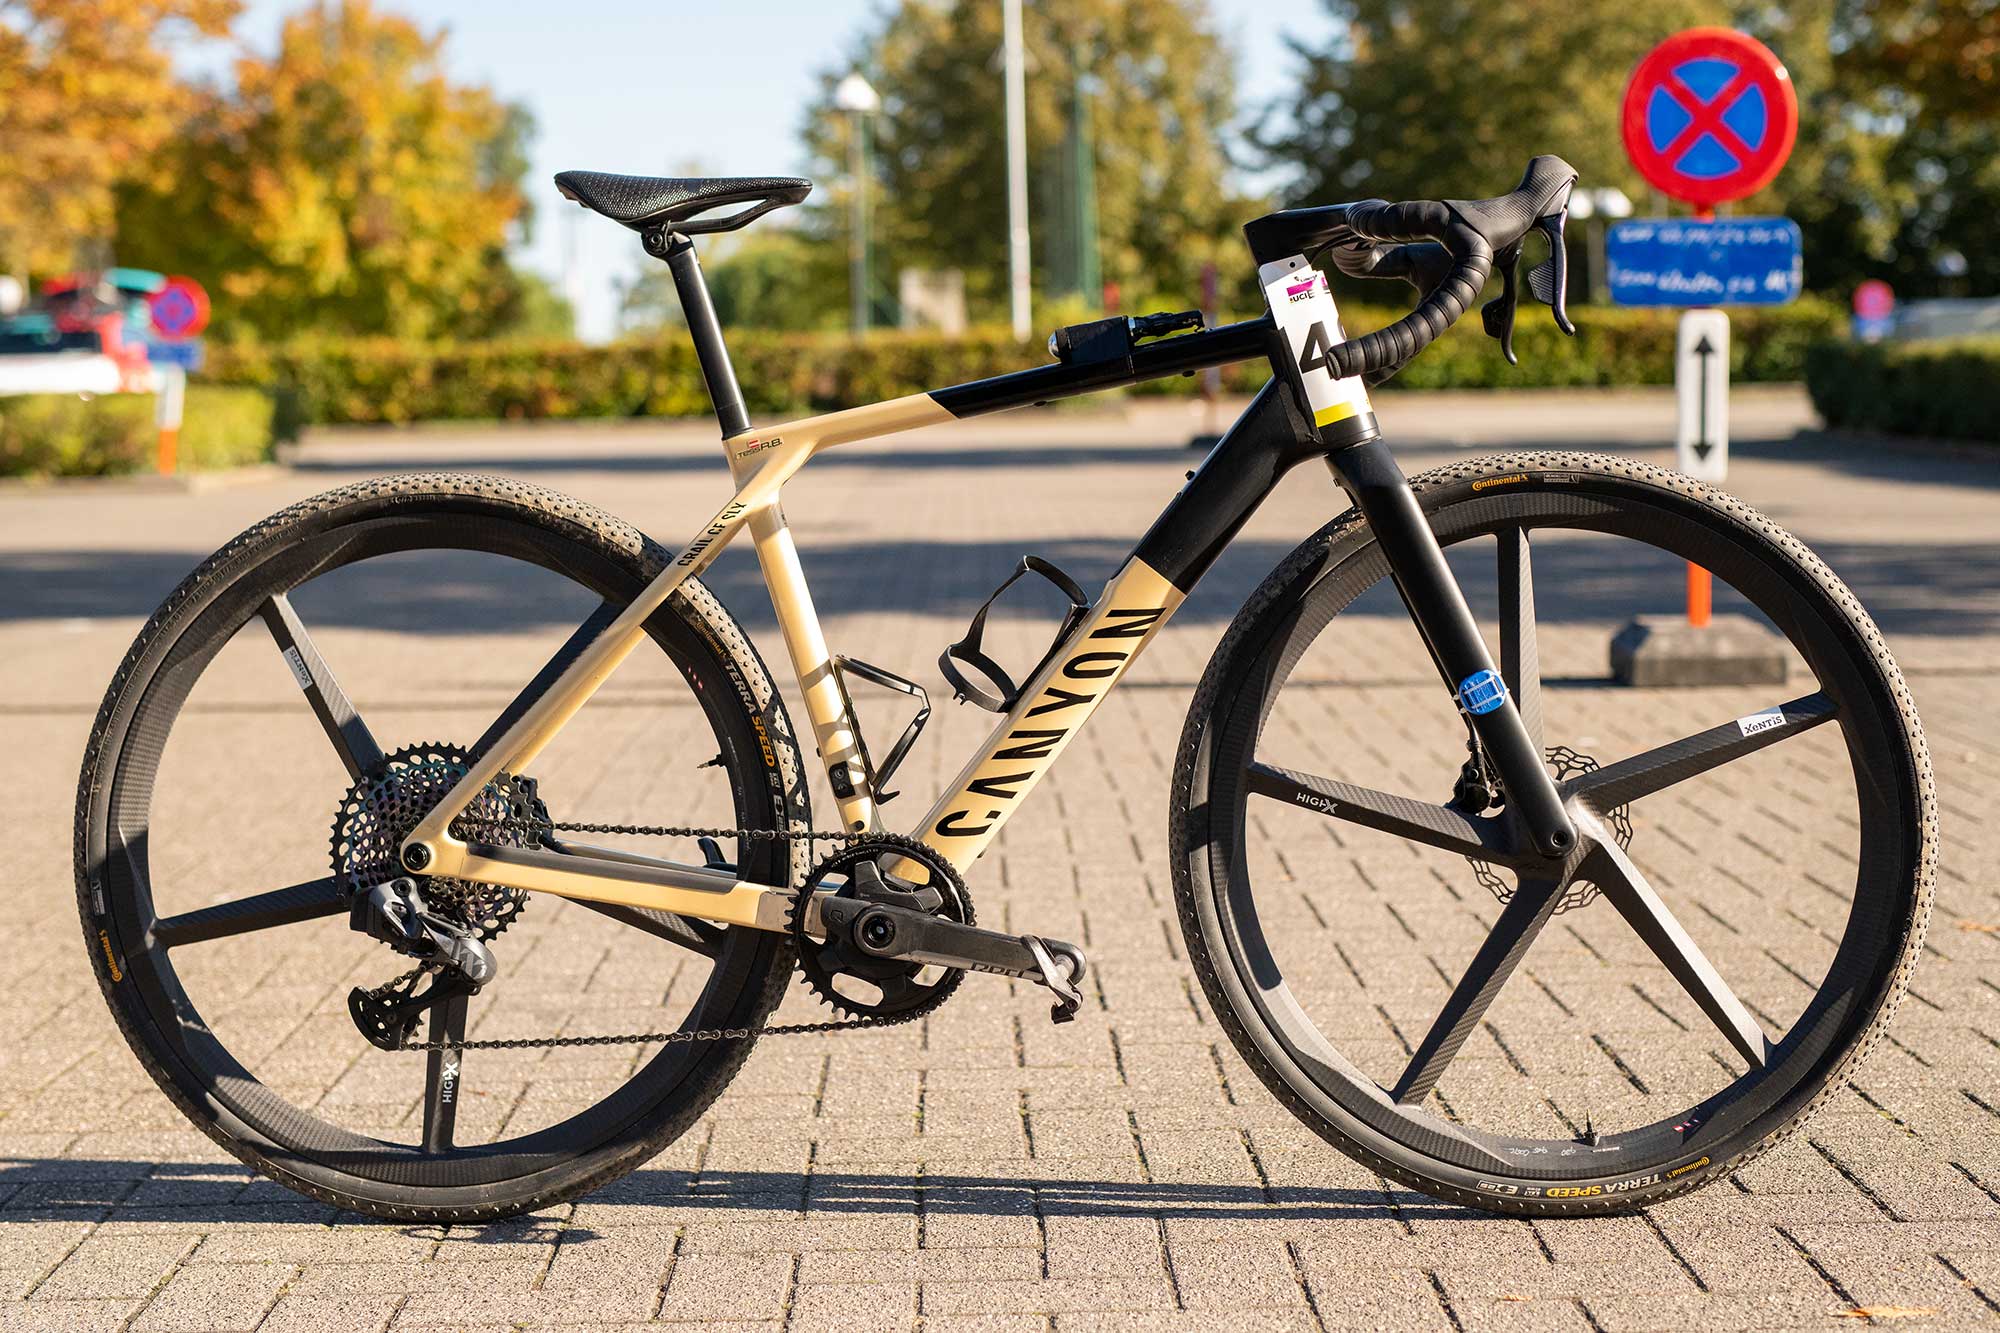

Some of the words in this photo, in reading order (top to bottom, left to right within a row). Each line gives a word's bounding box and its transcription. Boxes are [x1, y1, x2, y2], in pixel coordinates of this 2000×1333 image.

[1299, 320, 1346, 379] 4
[1472, 475, 1521, 491] Continental
[677, 538, 714, 567] GRAIL
[707, 523, 726, 535] CF
[721, 502, 747, 520] SLX
[725, 663, 758, 715] TERRA
[752, 715, 775, 767] SPEED
[936, 608, 1167, 837] CANYON
[1546, 1184, 1602, 1197] SPEED
[1605, 1173, 1662, 1194] TERRA
